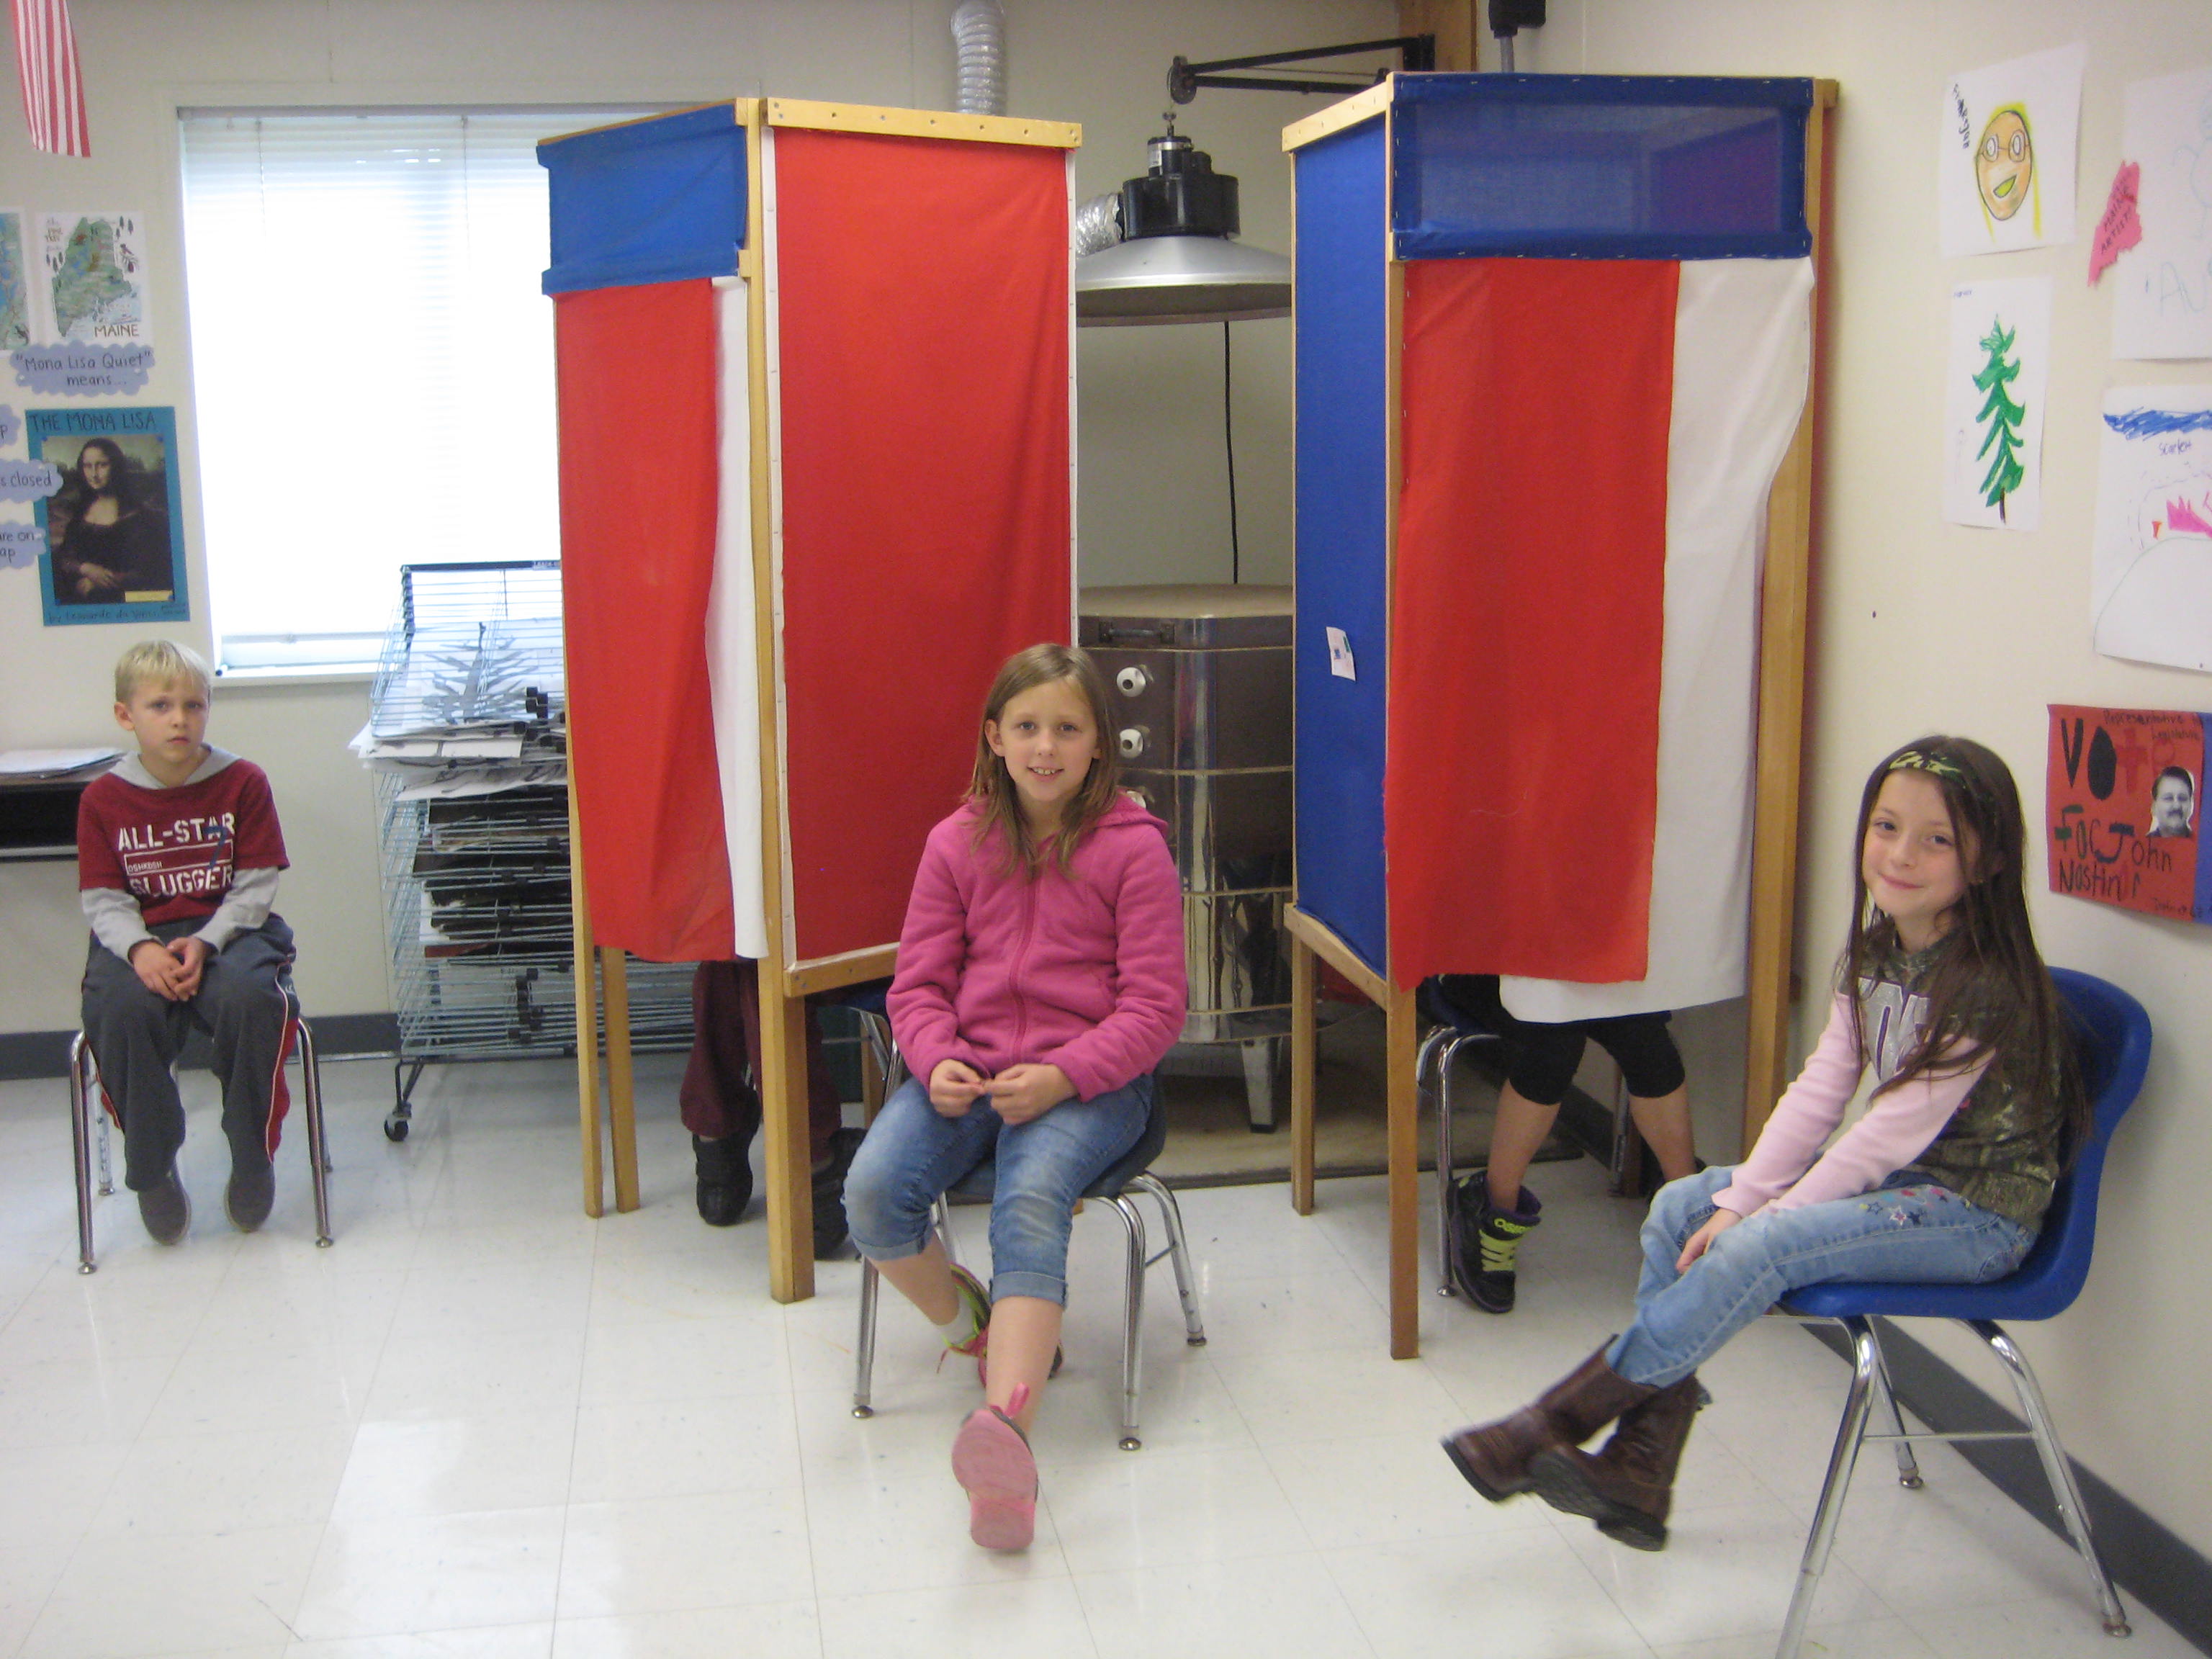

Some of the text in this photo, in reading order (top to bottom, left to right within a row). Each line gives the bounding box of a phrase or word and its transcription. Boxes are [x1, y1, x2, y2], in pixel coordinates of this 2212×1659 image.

[94, 325, 139, 338] MAINE
[68, 354, 95, 369] Lisa
[30, 411, 156, 431] THE MONA LISA
[10, 470, 52, 487] closed
[17, 531, 35, 541] on
[0, 547, 16, 563] ap
[118, 811, 236, 851] ALL-STAR
[129, 865, 234, 898] SLUGGER
